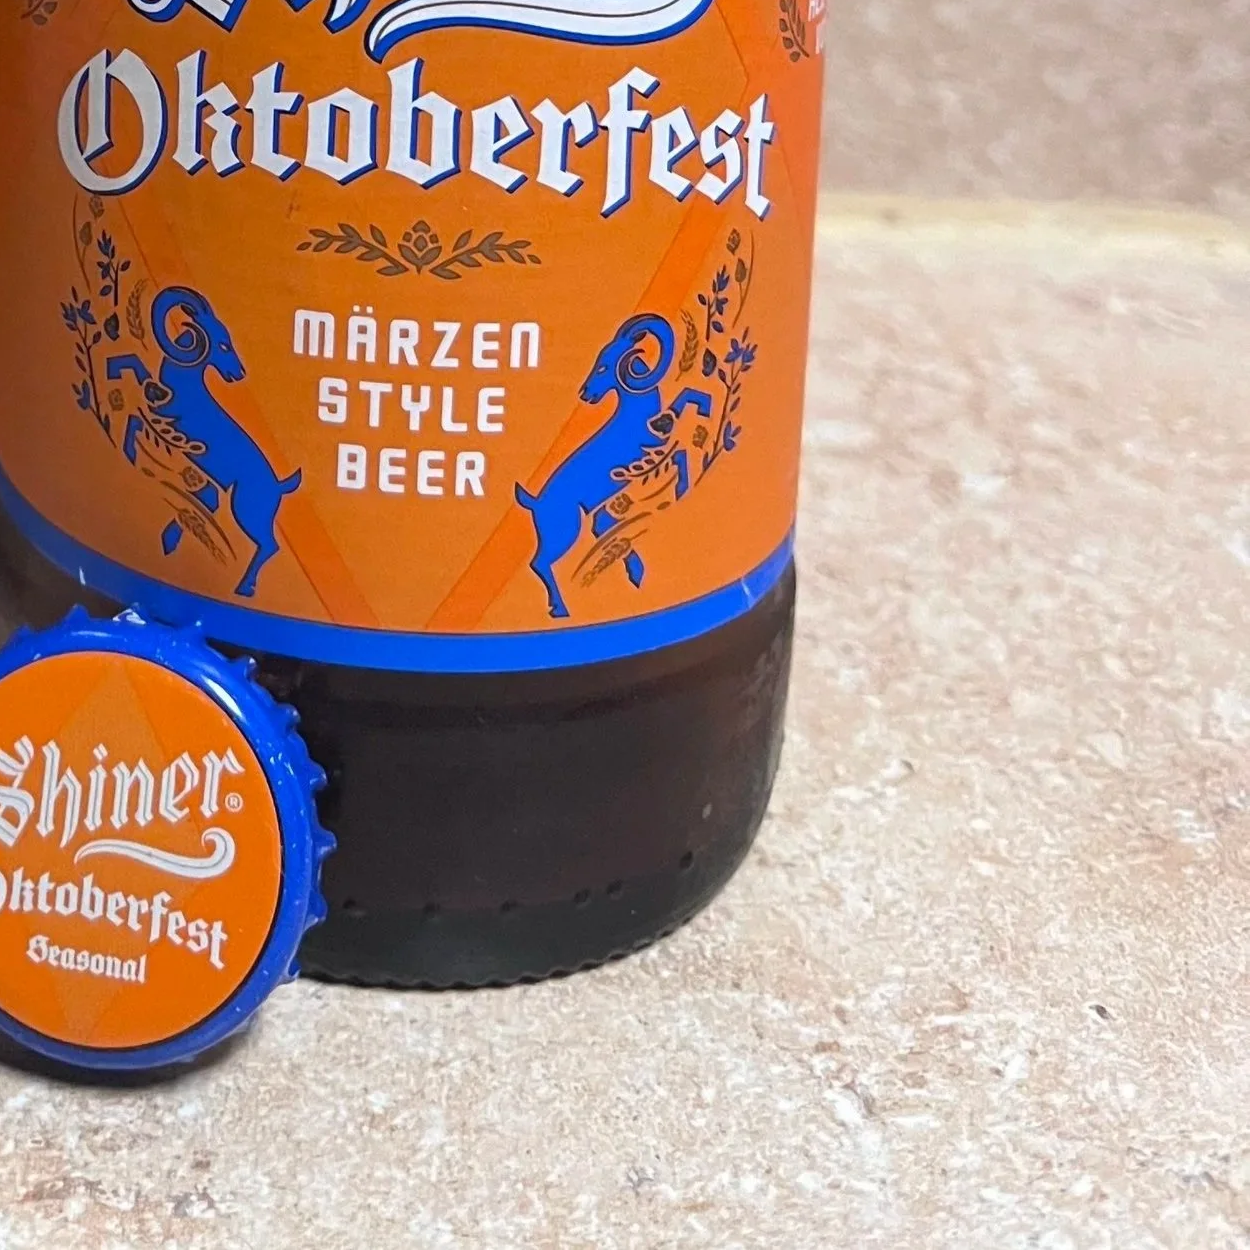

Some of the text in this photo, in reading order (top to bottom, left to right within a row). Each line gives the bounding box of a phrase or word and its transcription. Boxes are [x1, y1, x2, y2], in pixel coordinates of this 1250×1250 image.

[57, 47, 774, 219] Oktoberfest
[293, 305, 540, 369] MÄRZEN
[318, 376, 506, 432] STYLE
[336, 443, 486, 497] BEER
[26, 934, 147, 984] Seasonal
